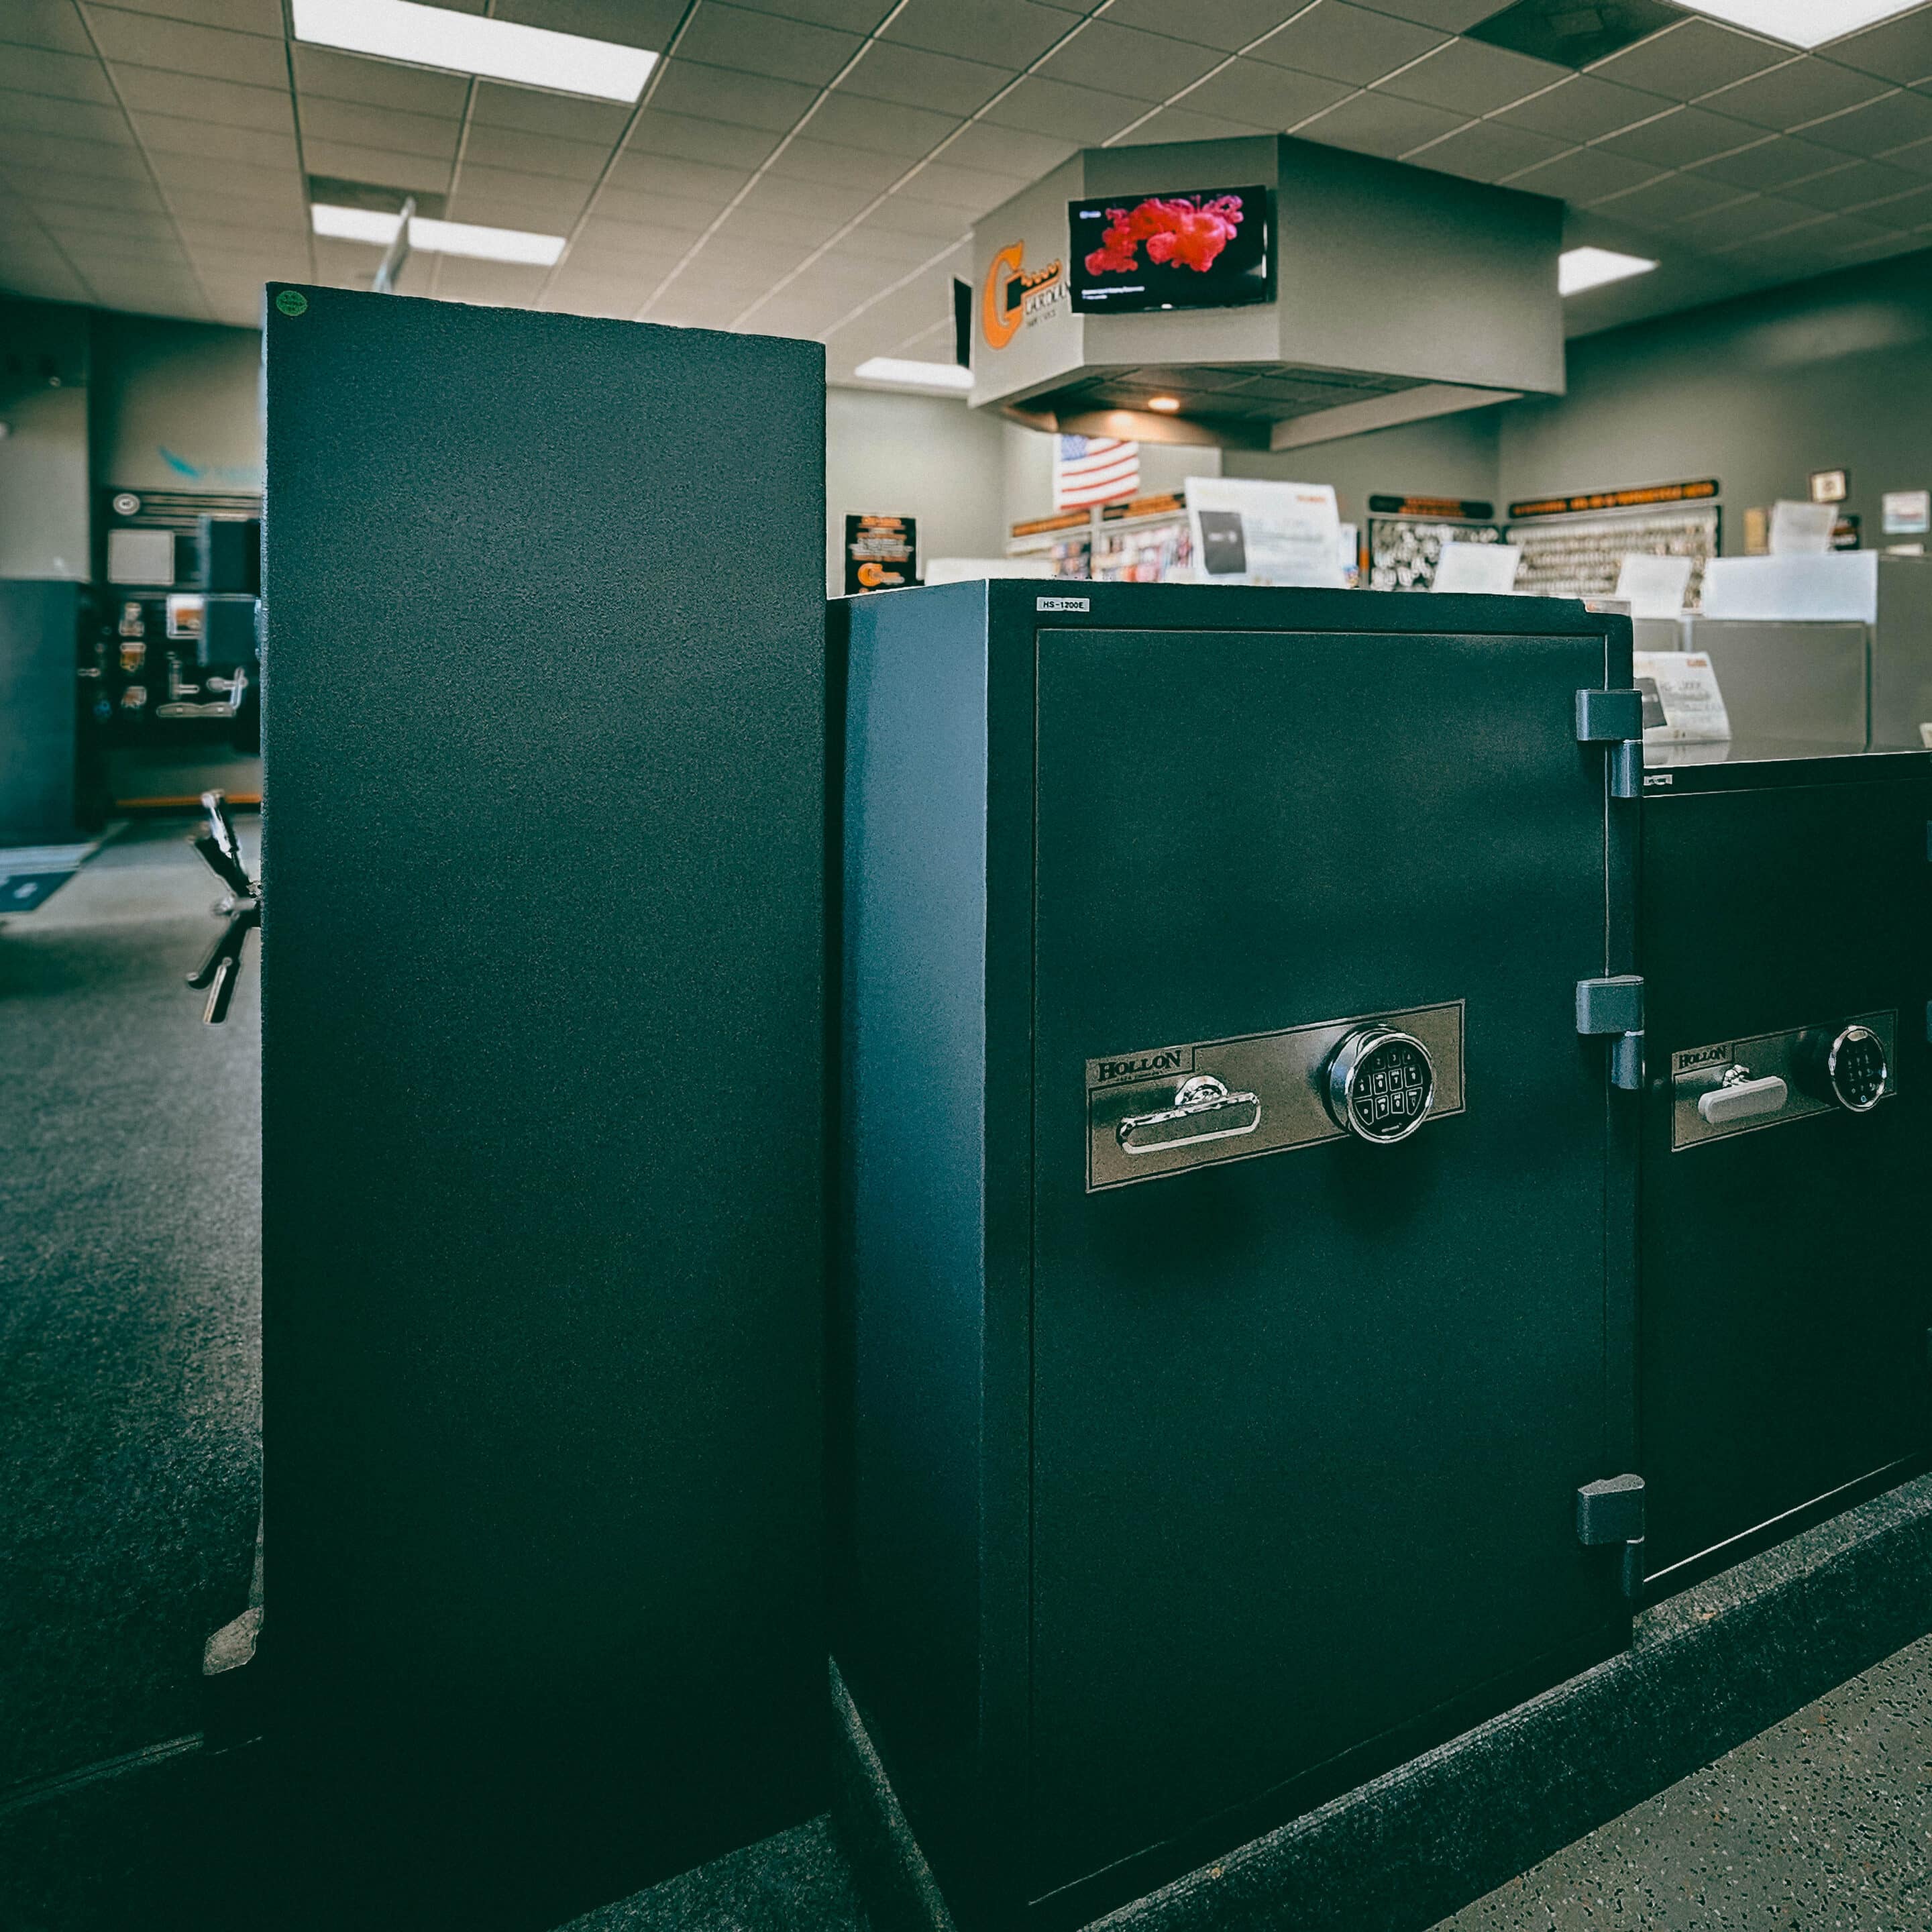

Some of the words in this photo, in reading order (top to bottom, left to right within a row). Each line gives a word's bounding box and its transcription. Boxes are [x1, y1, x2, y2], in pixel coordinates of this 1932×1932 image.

[1042, 600, 1085, 609] HS-1200E
[1098, 1049, 1181, 1082] HOLLON
[1678, 1045, 1728, 1069] HOLLON
